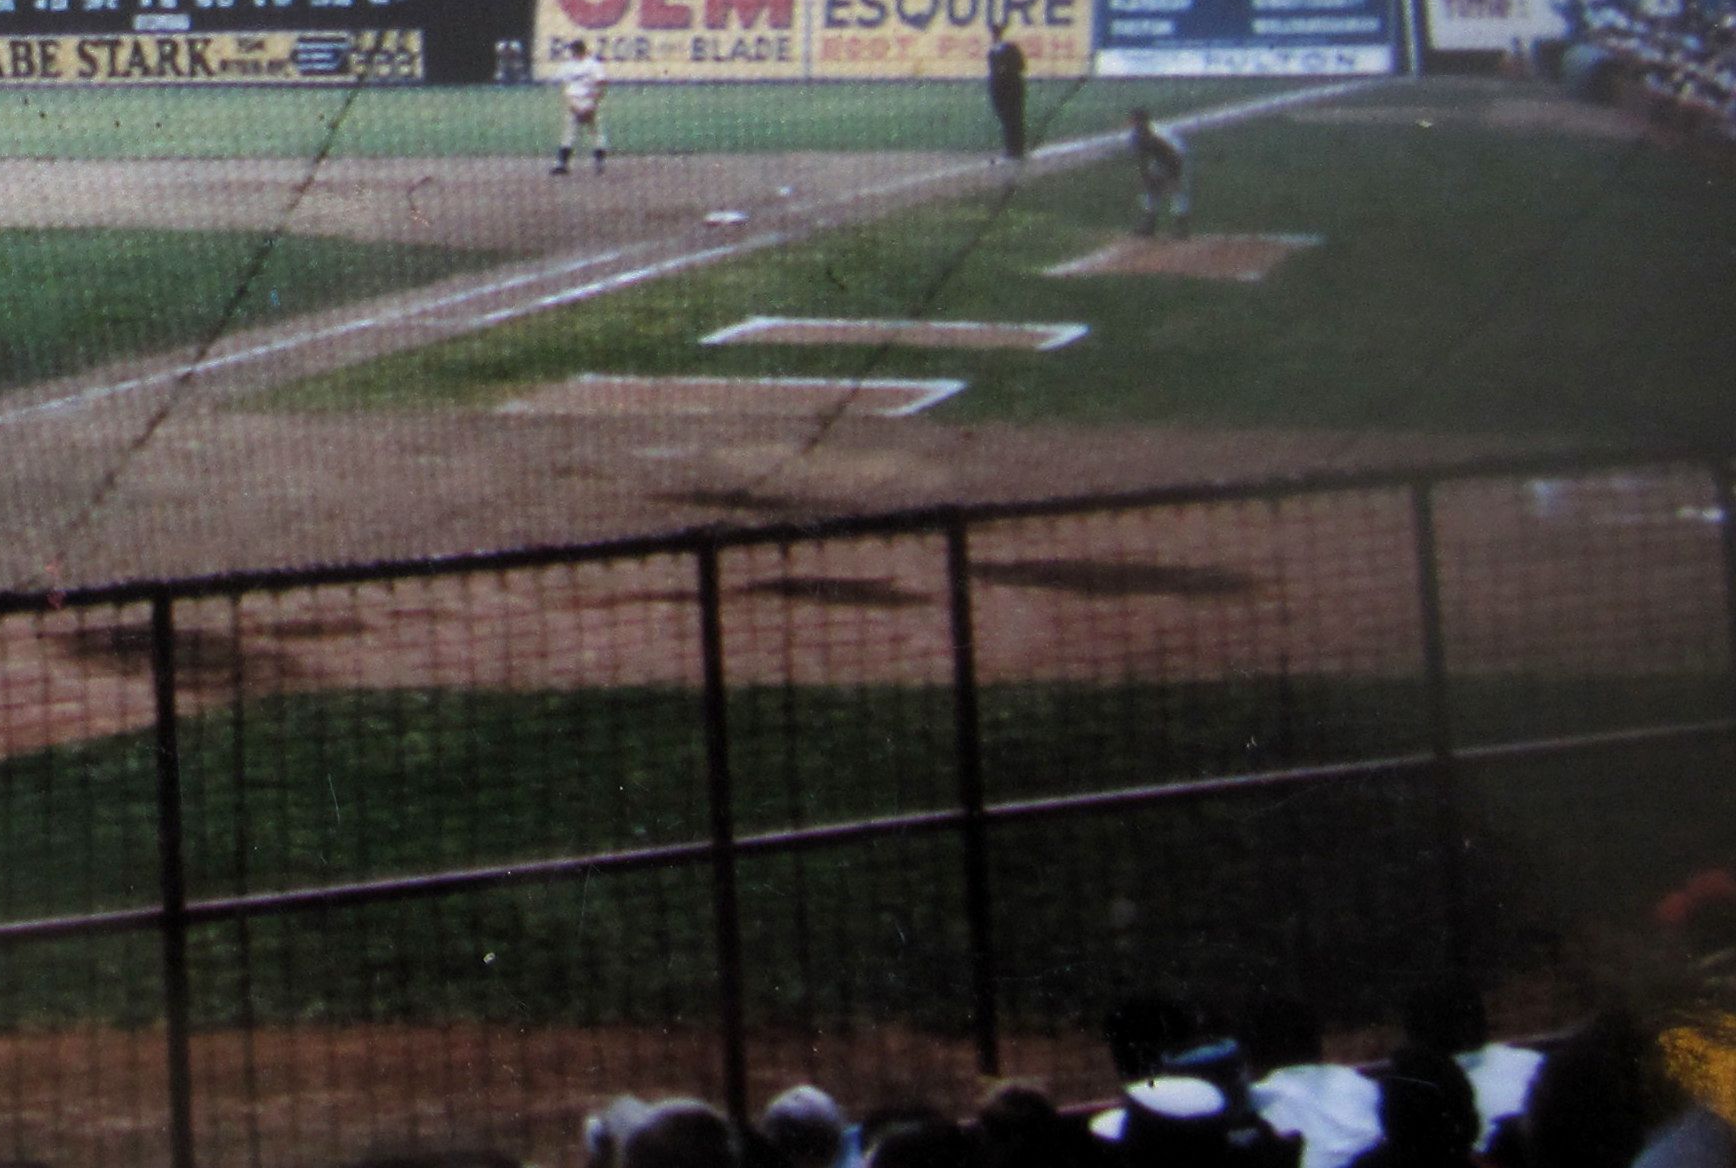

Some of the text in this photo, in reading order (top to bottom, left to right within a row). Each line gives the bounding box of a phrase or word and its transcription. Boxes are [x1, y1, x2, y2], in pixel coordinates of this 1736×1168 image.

[77, 37, 215, 78] STARK
[549, 36, 650, 62] RZOR
[692, 35, 793, 62] BLADE
